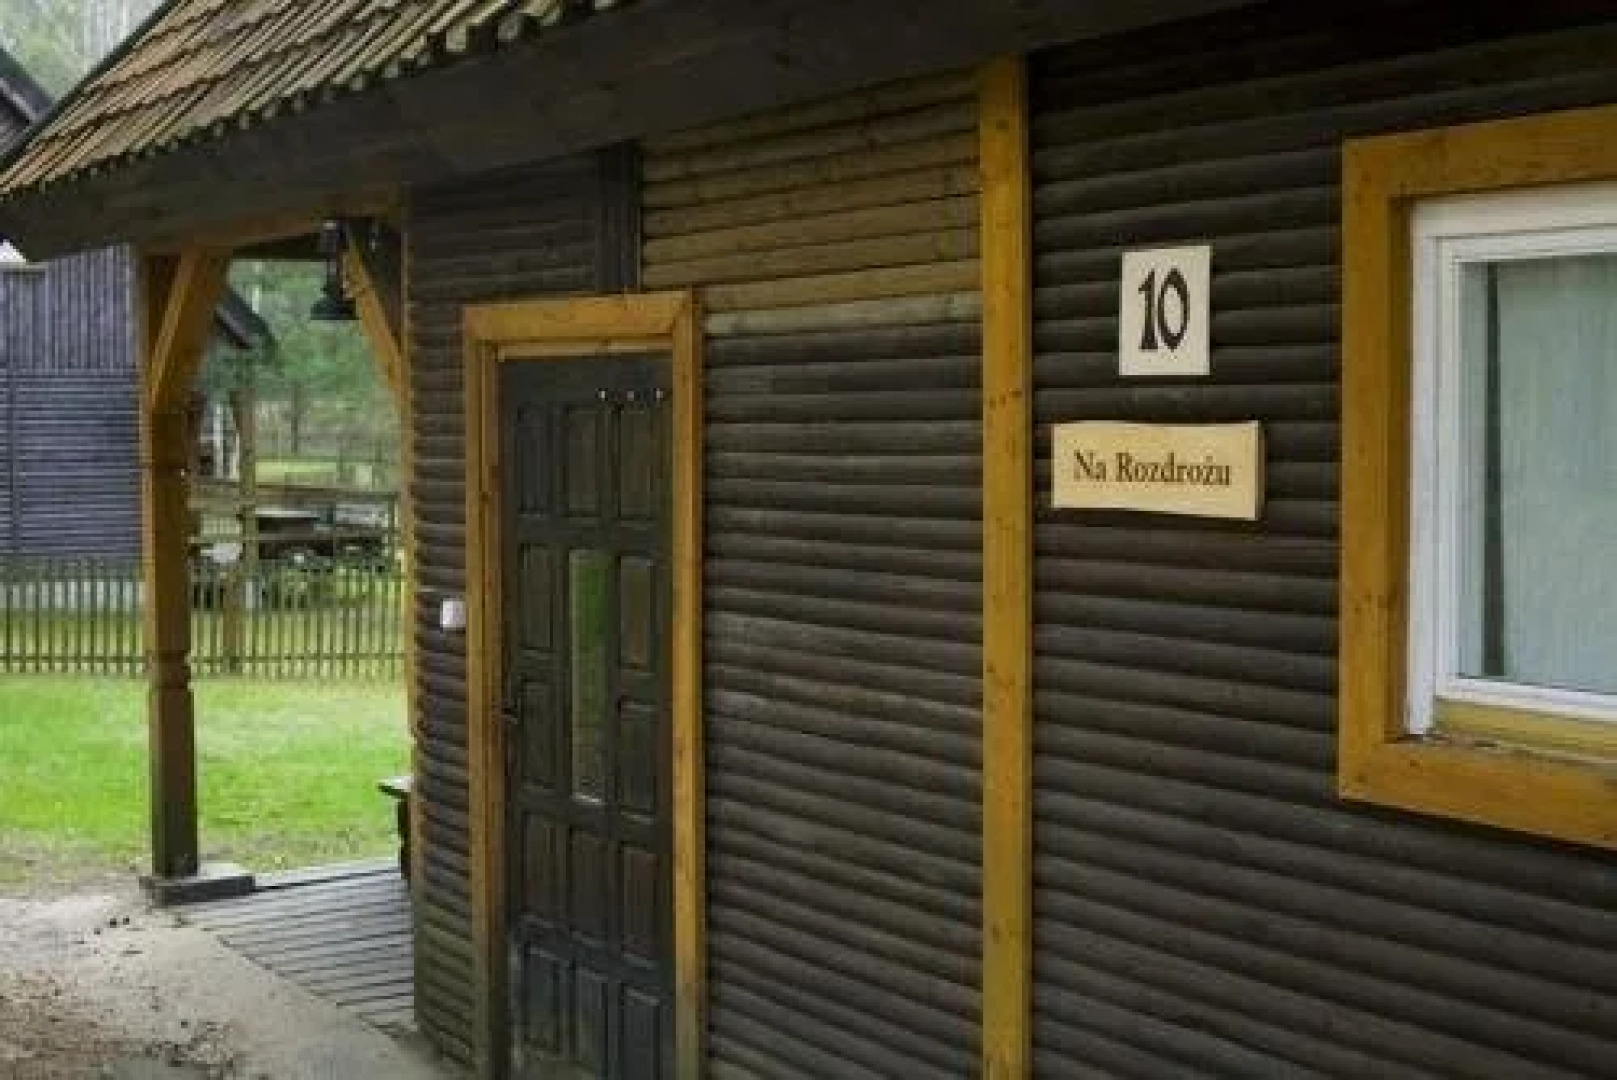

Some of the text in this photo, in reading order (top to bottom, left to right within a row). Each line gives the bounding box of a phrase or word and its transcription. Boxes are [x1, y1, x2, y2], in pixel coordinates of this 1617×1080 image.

[1138, 267, 1190, 352] 10
[1073, 450, 1231, 486] Na Rozdrożu
